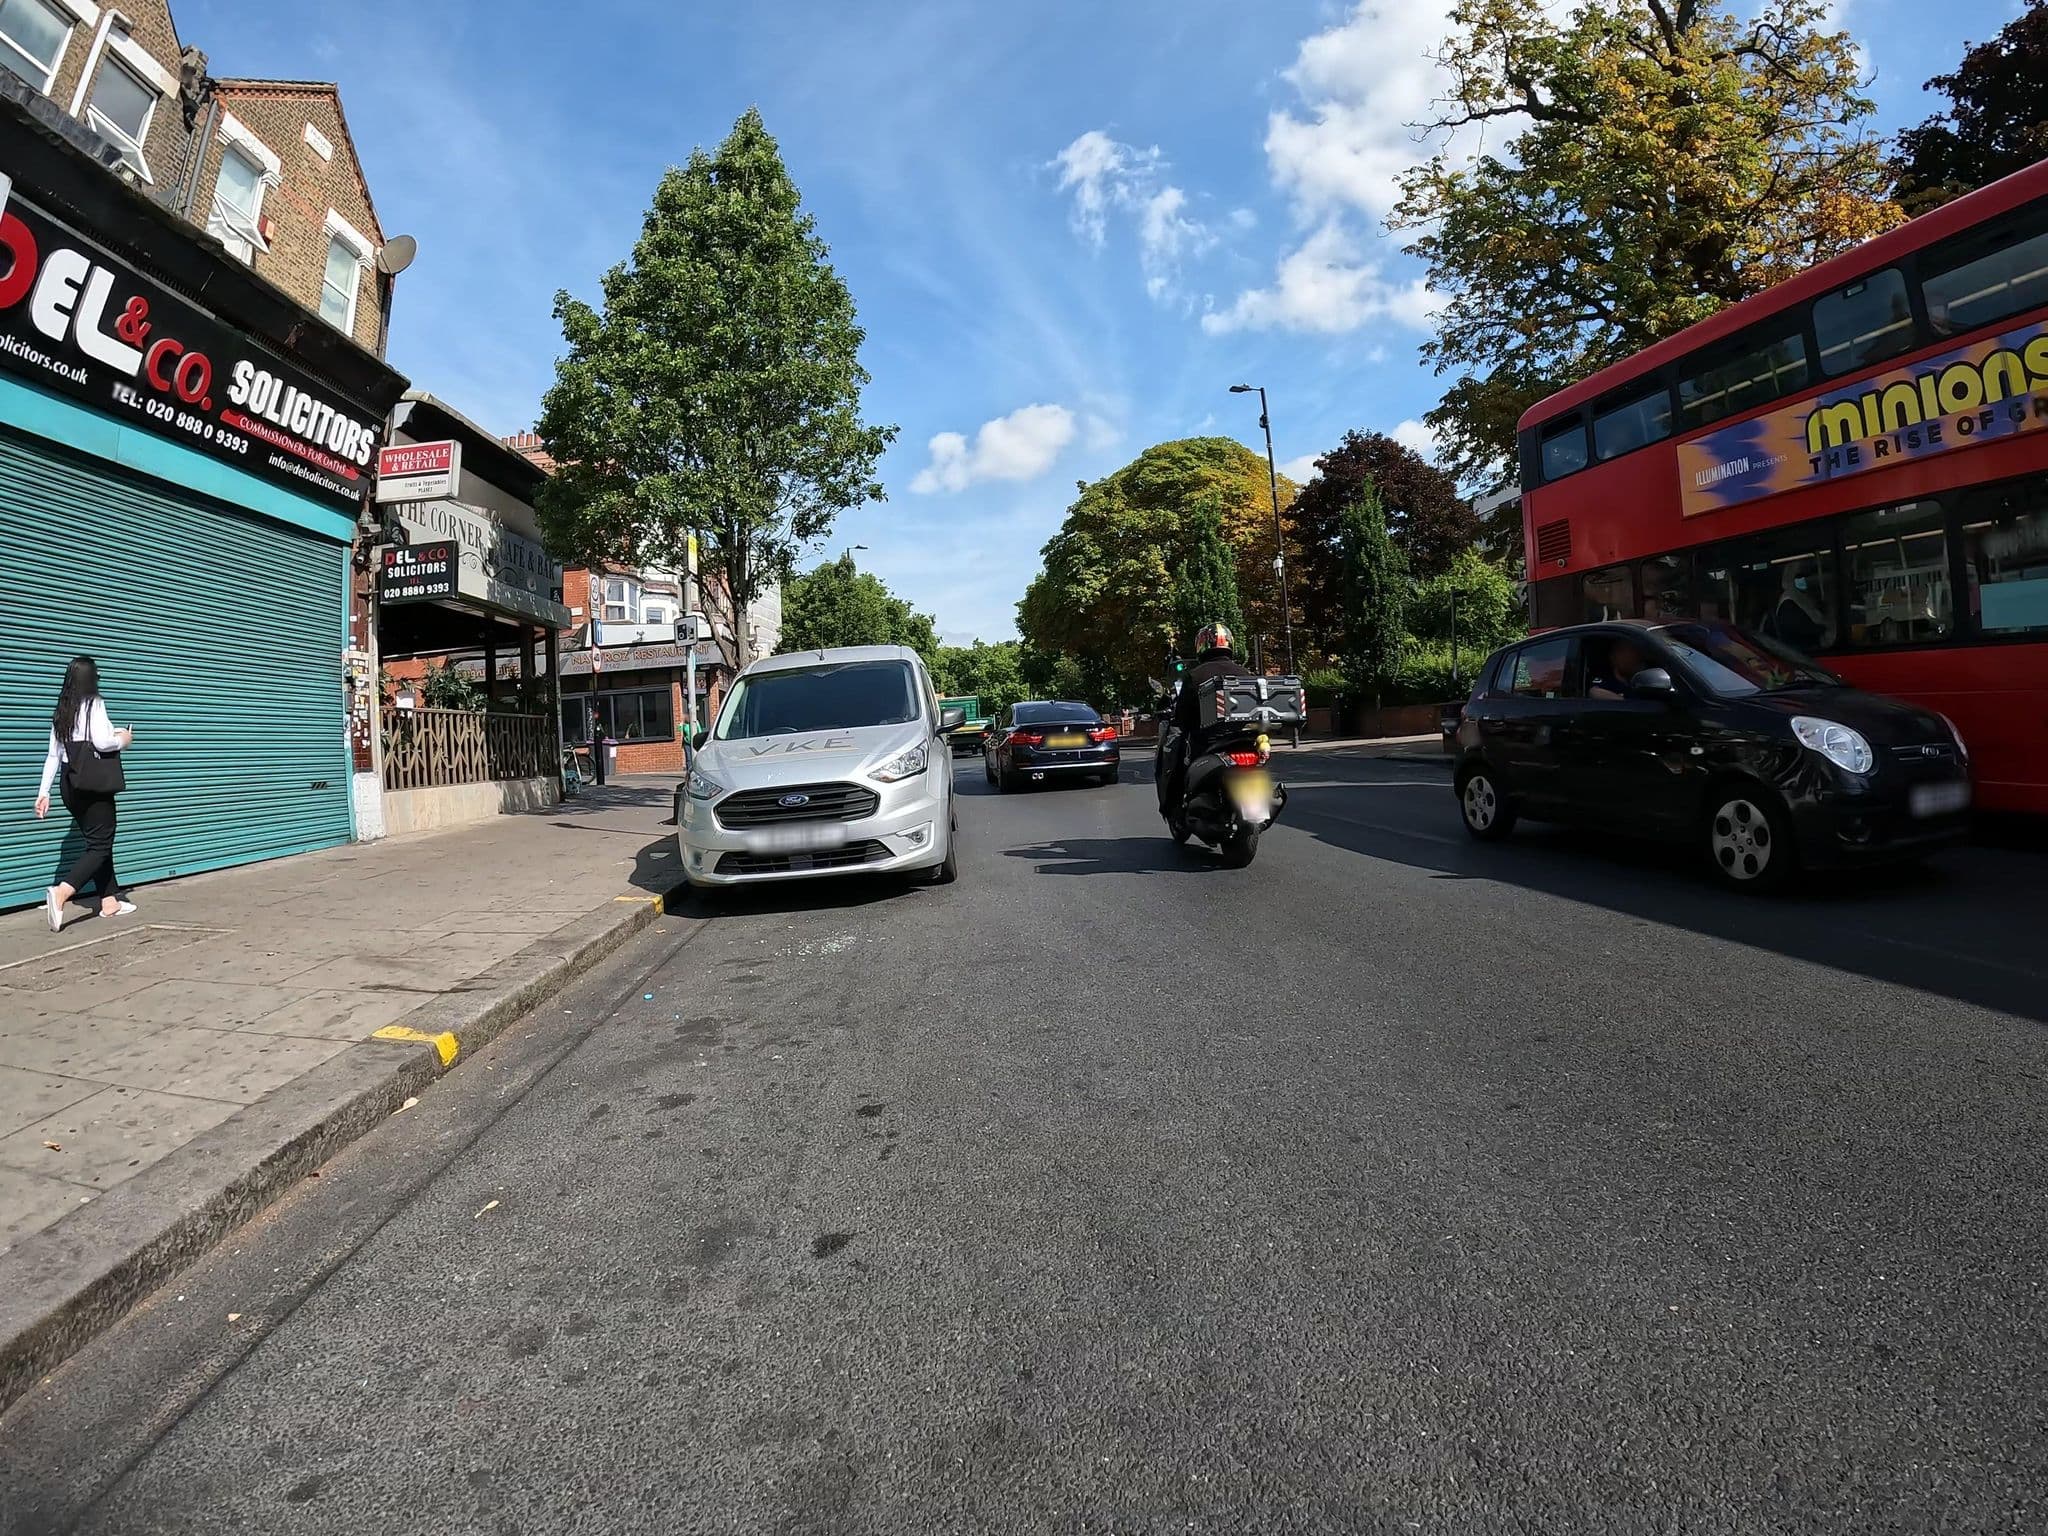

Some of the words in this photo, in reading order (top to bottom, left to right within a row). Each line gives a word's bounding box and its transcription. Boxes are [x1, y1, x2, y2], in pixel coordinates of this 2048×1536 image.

[115, 296, 152, 348] &
[145, 338, 213, 411] CO.
[227, 360, 375, 466] SOLICITORS
[112, 381, 143, 410] TEL:
[146, 398, 174, 422] 020
[215, 429, 249, 455] 9393
[239, 416, 307, 454] COMMISSIONERS
[307, 447, 323, 464] FOR
[323, 455, 347, 475] OATHS
[385, 448, 449, 463] WHOLESALE
[1809, 446, 1860, 474] THE
[1874, 423, 1943, 458] RISE
[1957, 410, 1994, 435] OF
[268, 452, 361, 502] info@delsolicitors.co.uk
[391, 462, 398, 472] &
[401, 459, 439, 471] RETAIL
[1695, 457, 1750, 487] ILLUMINATION
[1752, 454, 1788, 469] PRESENTS
[431, 507, 482, 549] CORNER
[385, 549, 416, 566] DEL
[387, 561, 447, 578] SOLICITORS
[384, 588, 401, 599] 020
[402, 585, 425, 597] 8880
[426, 582, 450, 594] 9393
[571, 650, 630, 665] NAROZ
[633, 643, 711, 660] RESTAURNT
